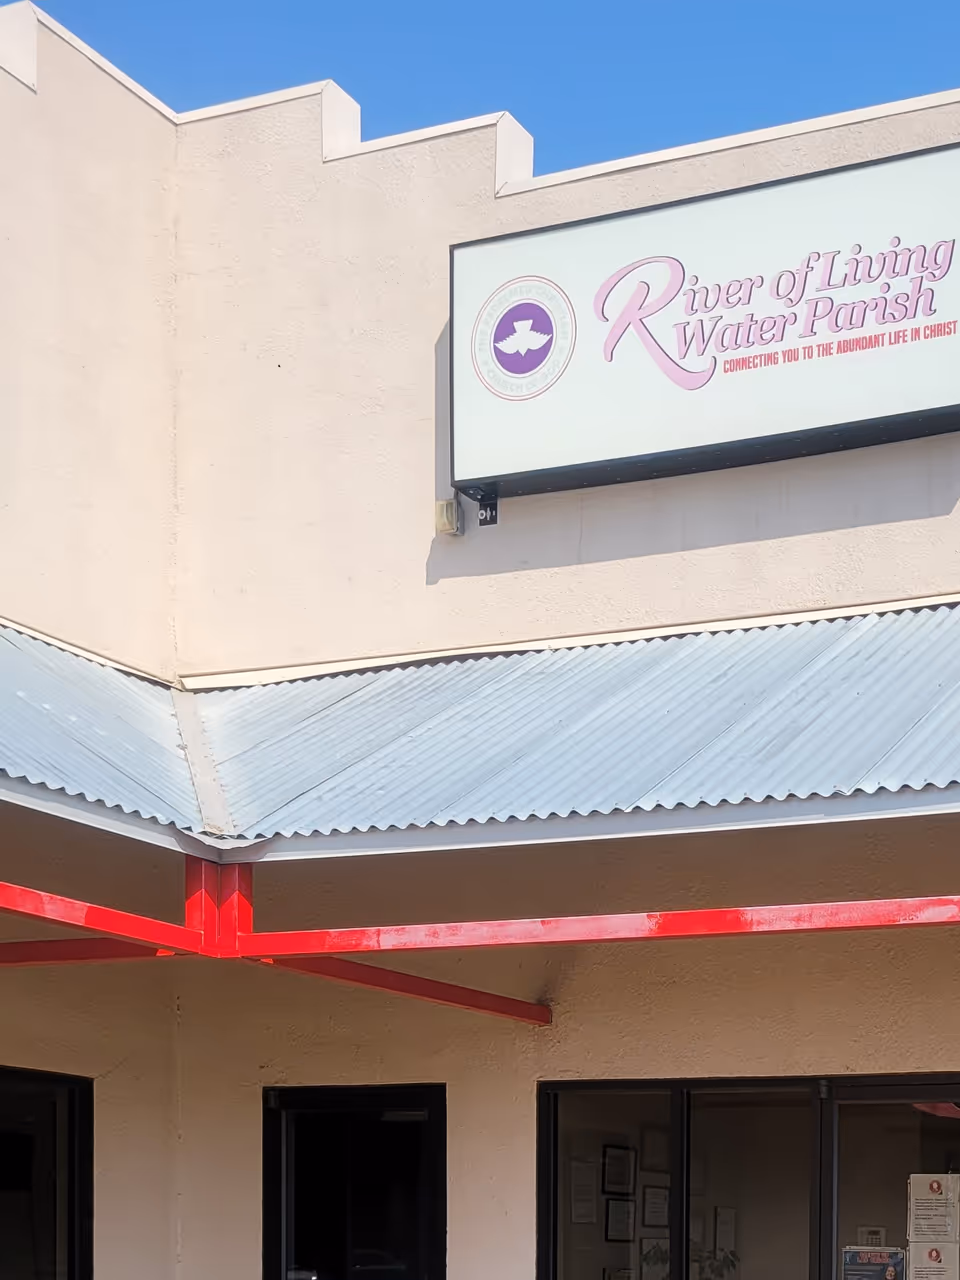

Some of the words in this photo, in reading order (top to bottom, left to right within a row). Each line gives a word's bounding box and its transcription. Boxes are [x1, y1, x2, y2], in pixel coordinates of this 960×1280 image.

[593, 256, 764, 390] River
[770, 252, 820, 308] of
[815, 236, 956, 292] Living
[673, 312, 797, 361] Water
[798, 276, 937, 339] Parish
[723, 351, 780, 374] CONNECTING
[782, 347, 799, 363] YOU
[802, 345, 814, 360] TO
[816, 341, 834, 357] THE
[836, 332, 887, 355] ABUNDANT
[888, 329, 908, 346] LIFE
[911, 326, 921, 342] IN
[923, 320, 958, 340] CHRIST
